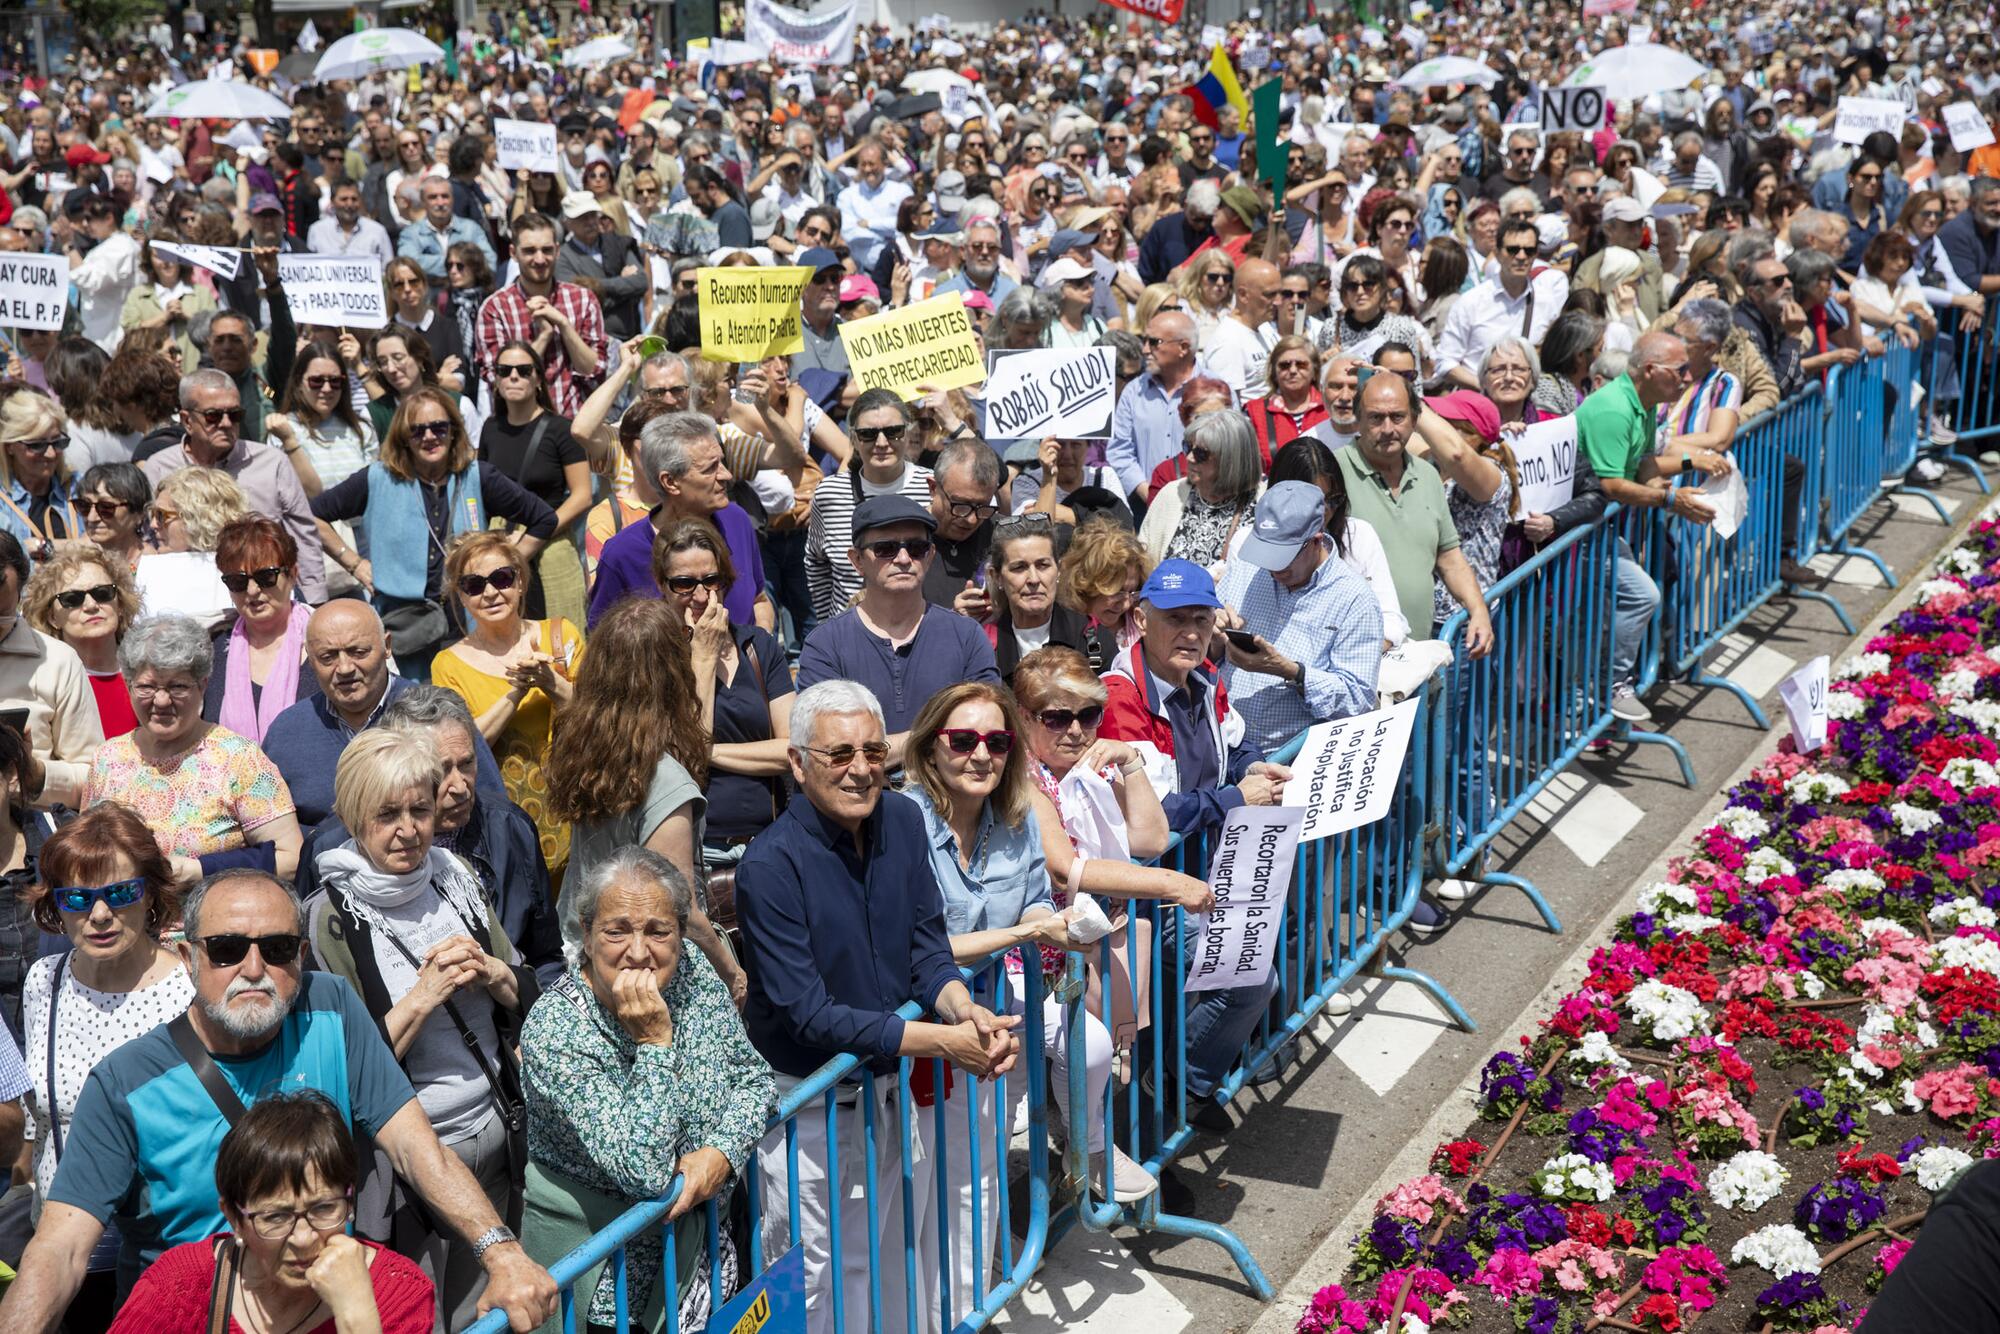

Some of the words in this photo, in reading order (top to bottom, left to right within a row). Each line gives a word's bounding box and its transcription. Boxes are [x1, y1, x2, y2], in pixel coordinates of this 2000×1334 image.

[1542, 88, 1603, 130] NO
[21, 265, 57, 287] CURA
[327, 265, 376, 283] UNIVERSAL
[309, 292, 340, 309] PARA
[710, 278, 757, 305] Recursos
[13, 300, 30, 319] EL
[713, 319, 722, 345] la
[728, 317, 766, 344] Atención
[850, 336, 872, 360] NO
[872, 324, 904, 354] MÁS
[903, 310, 968, 347] MUERTES
[862, 366, 892, 390] POR
[890, 344, 979, 386] PRECARIEDAD.
[1050, 348, 1112, 408] SALUD!
[1330, 722, 1348, 737] la
[1348, 729, 1365, 748] no
[1375, 716, 1394, 737] La
[1302, 739, 1338, 837] explotación.
[1330, 748, 1362, 814] justifica
[1354, 738, 1384, 812] vocación
[1225, 824, 1249, 846] Sus
[1249, 824, 1287, 902] Recortaron
[1214, 850, 1236, 904] muertos
[1209, 905, 1234, 924] les
[1246, 906, 1271, 917] la
[1234, 921, 1268, 976] Sanidad.
